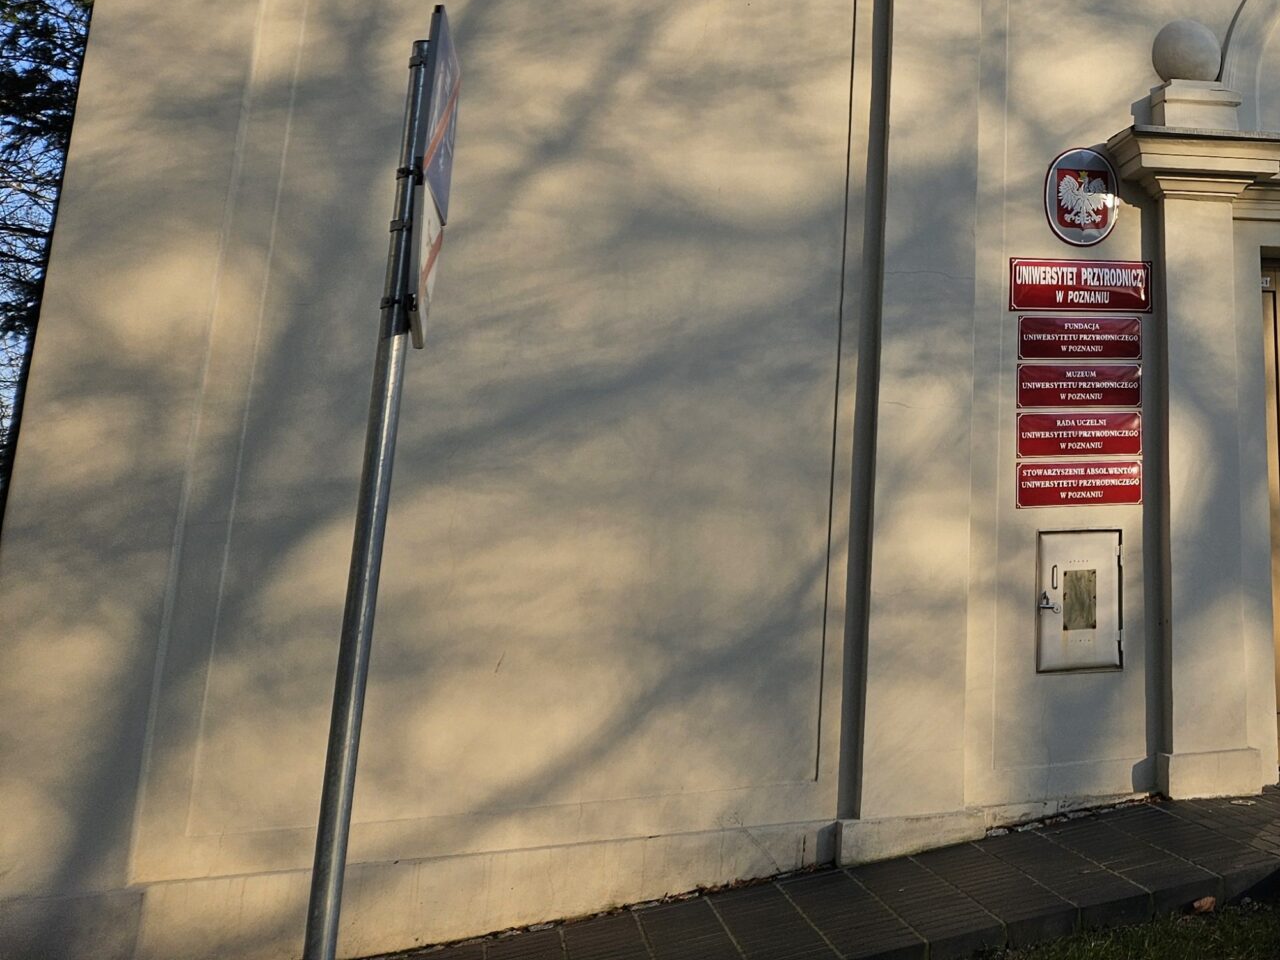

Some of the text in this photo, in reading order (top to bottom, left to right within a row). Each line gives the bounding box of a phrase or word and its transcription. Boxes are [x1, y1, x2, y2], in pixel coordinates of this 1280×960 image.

[1016, 266, 1146, 287] UNIWERSYTET PRZYRODNICZY
[1056, 291, 1109, 303] W POZNANIU
[1064, 323, 1100, 331] FUNDACJA
[1021, 430, 1139, 439] UNIWERSYTETU PRZYRODNICZEGO
[1022, 468, 1085, 476] STOWARZYSZENIE
[1021, 478, 1140, 488] UNIWERSYTETU PRZYRODNICZEGO
[1067, 491, 1103, 499] POZNANIU
